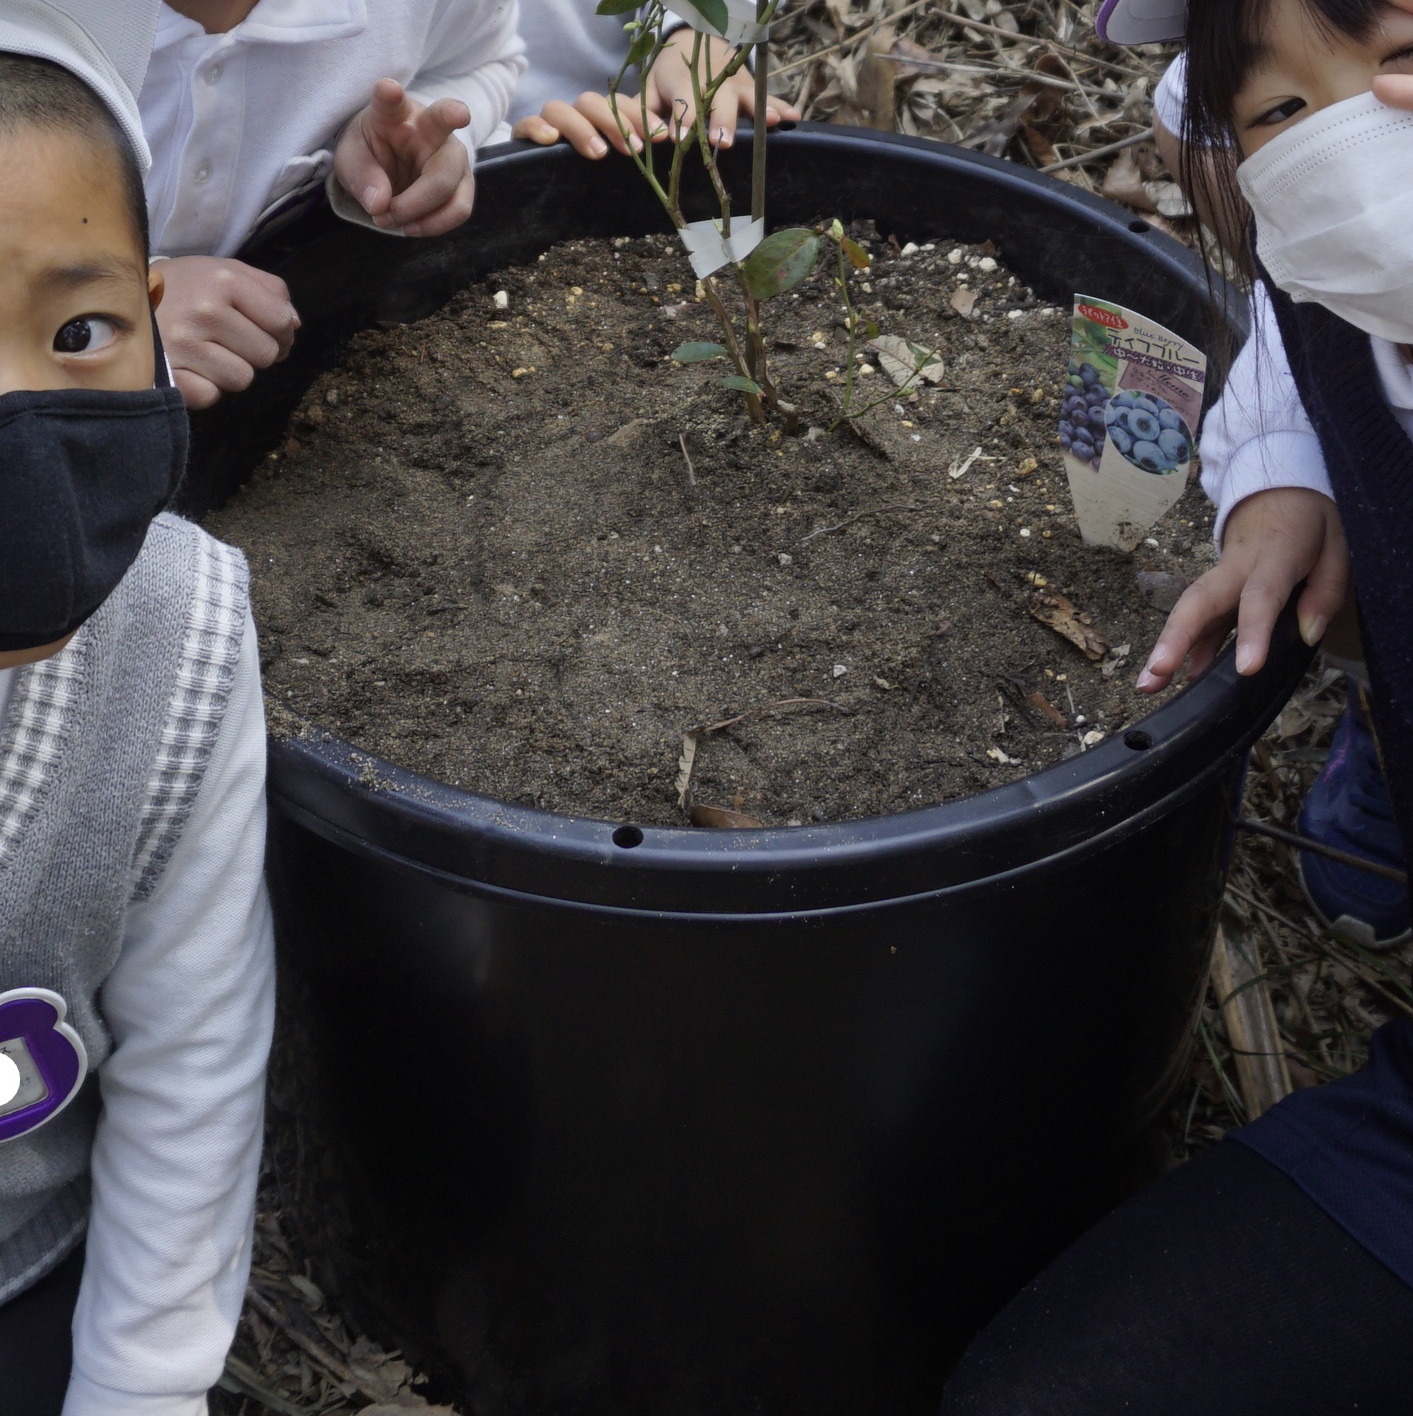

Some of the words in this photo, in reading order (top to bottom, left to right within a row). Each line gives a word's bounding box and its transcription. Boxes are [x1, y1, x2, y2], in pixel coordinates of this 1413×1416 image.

[1107, 328, 1200, 364] ティフブルー
[1134, 327, 1155, 340] Blue
[1158, 335, 1184, 351] Berry
